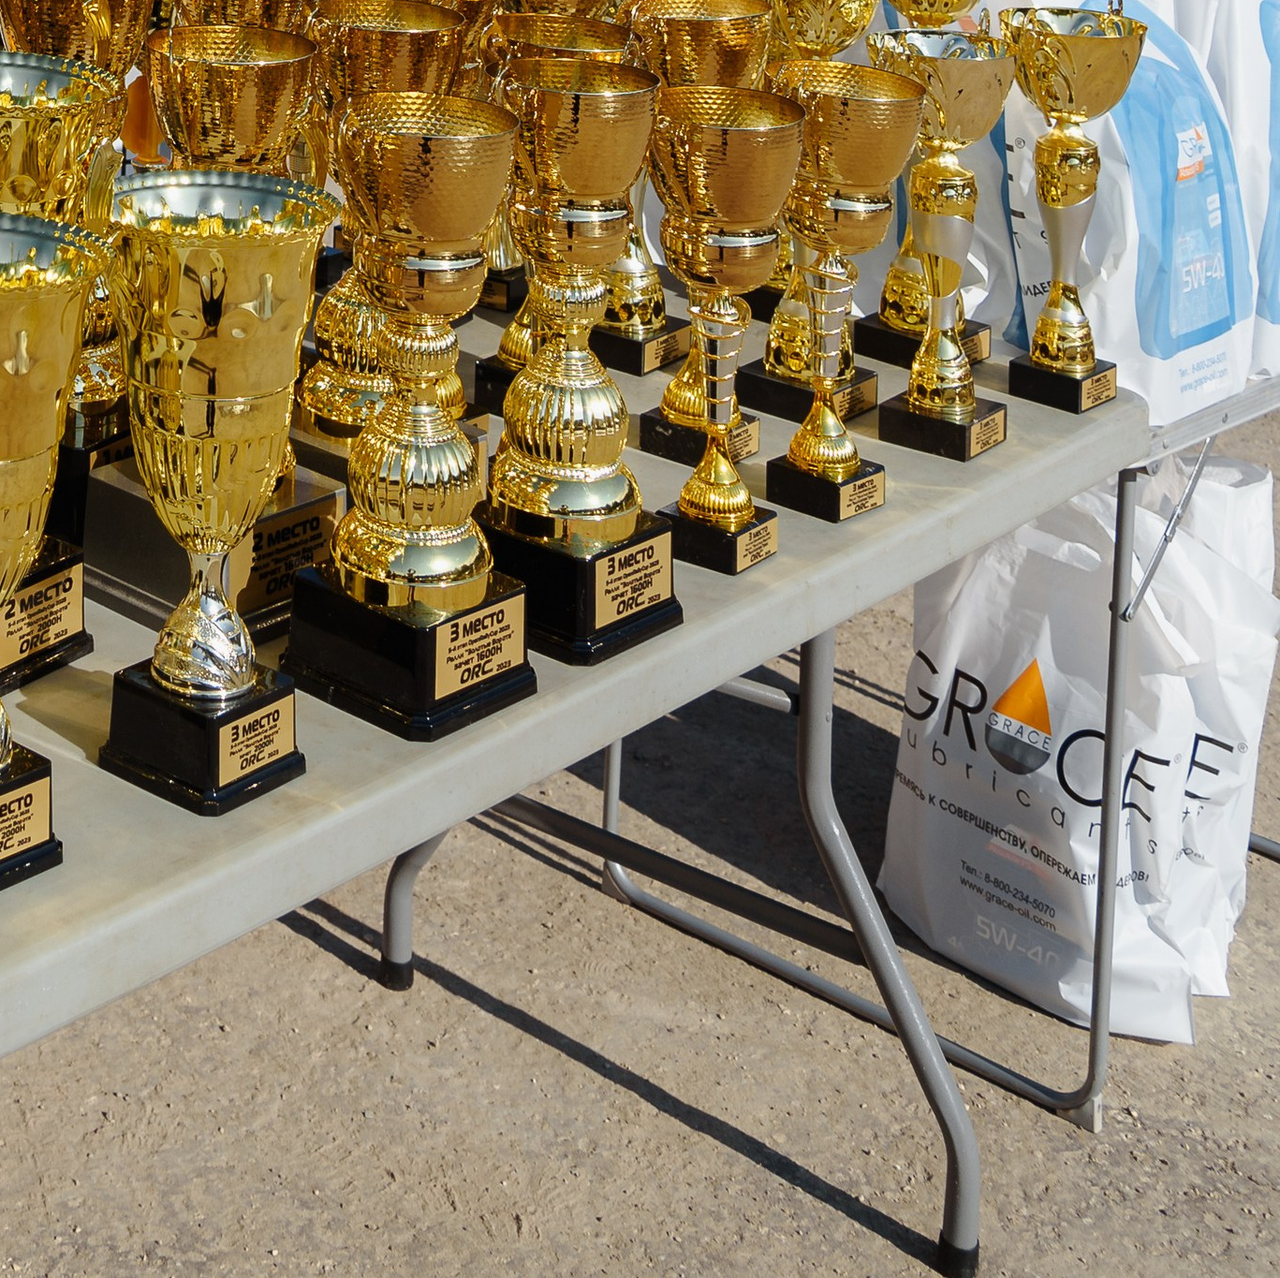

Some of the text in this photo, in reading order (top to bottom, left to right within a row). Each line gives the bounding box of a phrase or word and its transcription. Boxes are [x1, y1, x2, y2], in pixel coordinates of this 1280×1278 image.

[607, 545, 654, 575] 3 место
[4, 577, 72, 619] 2 место
[616, 593, 644, 615] ORC
[19, 629, 50, 653] ORC
[450, 608, 504, 641] 3 место
[460, 658, 493, 683] ORC
[231, 708, 279, 742] 3 место
[987, 711, 1053, 752] GRACE
[240, 750, 265, 769] ORC
[894, 768, 925, 801] РЕМЯСЬ
[928, 792, 937, 806] К
[938, 798, 1028, 854] СОВЕРШЕНСТВУ,
[1030, 845, 1096, 886] ОПЕРЕЖАЕМ
[959, 875, 1057, 932] www.grace-oil.com
[984, 871, 1056, 919] 8-800-234-5070
